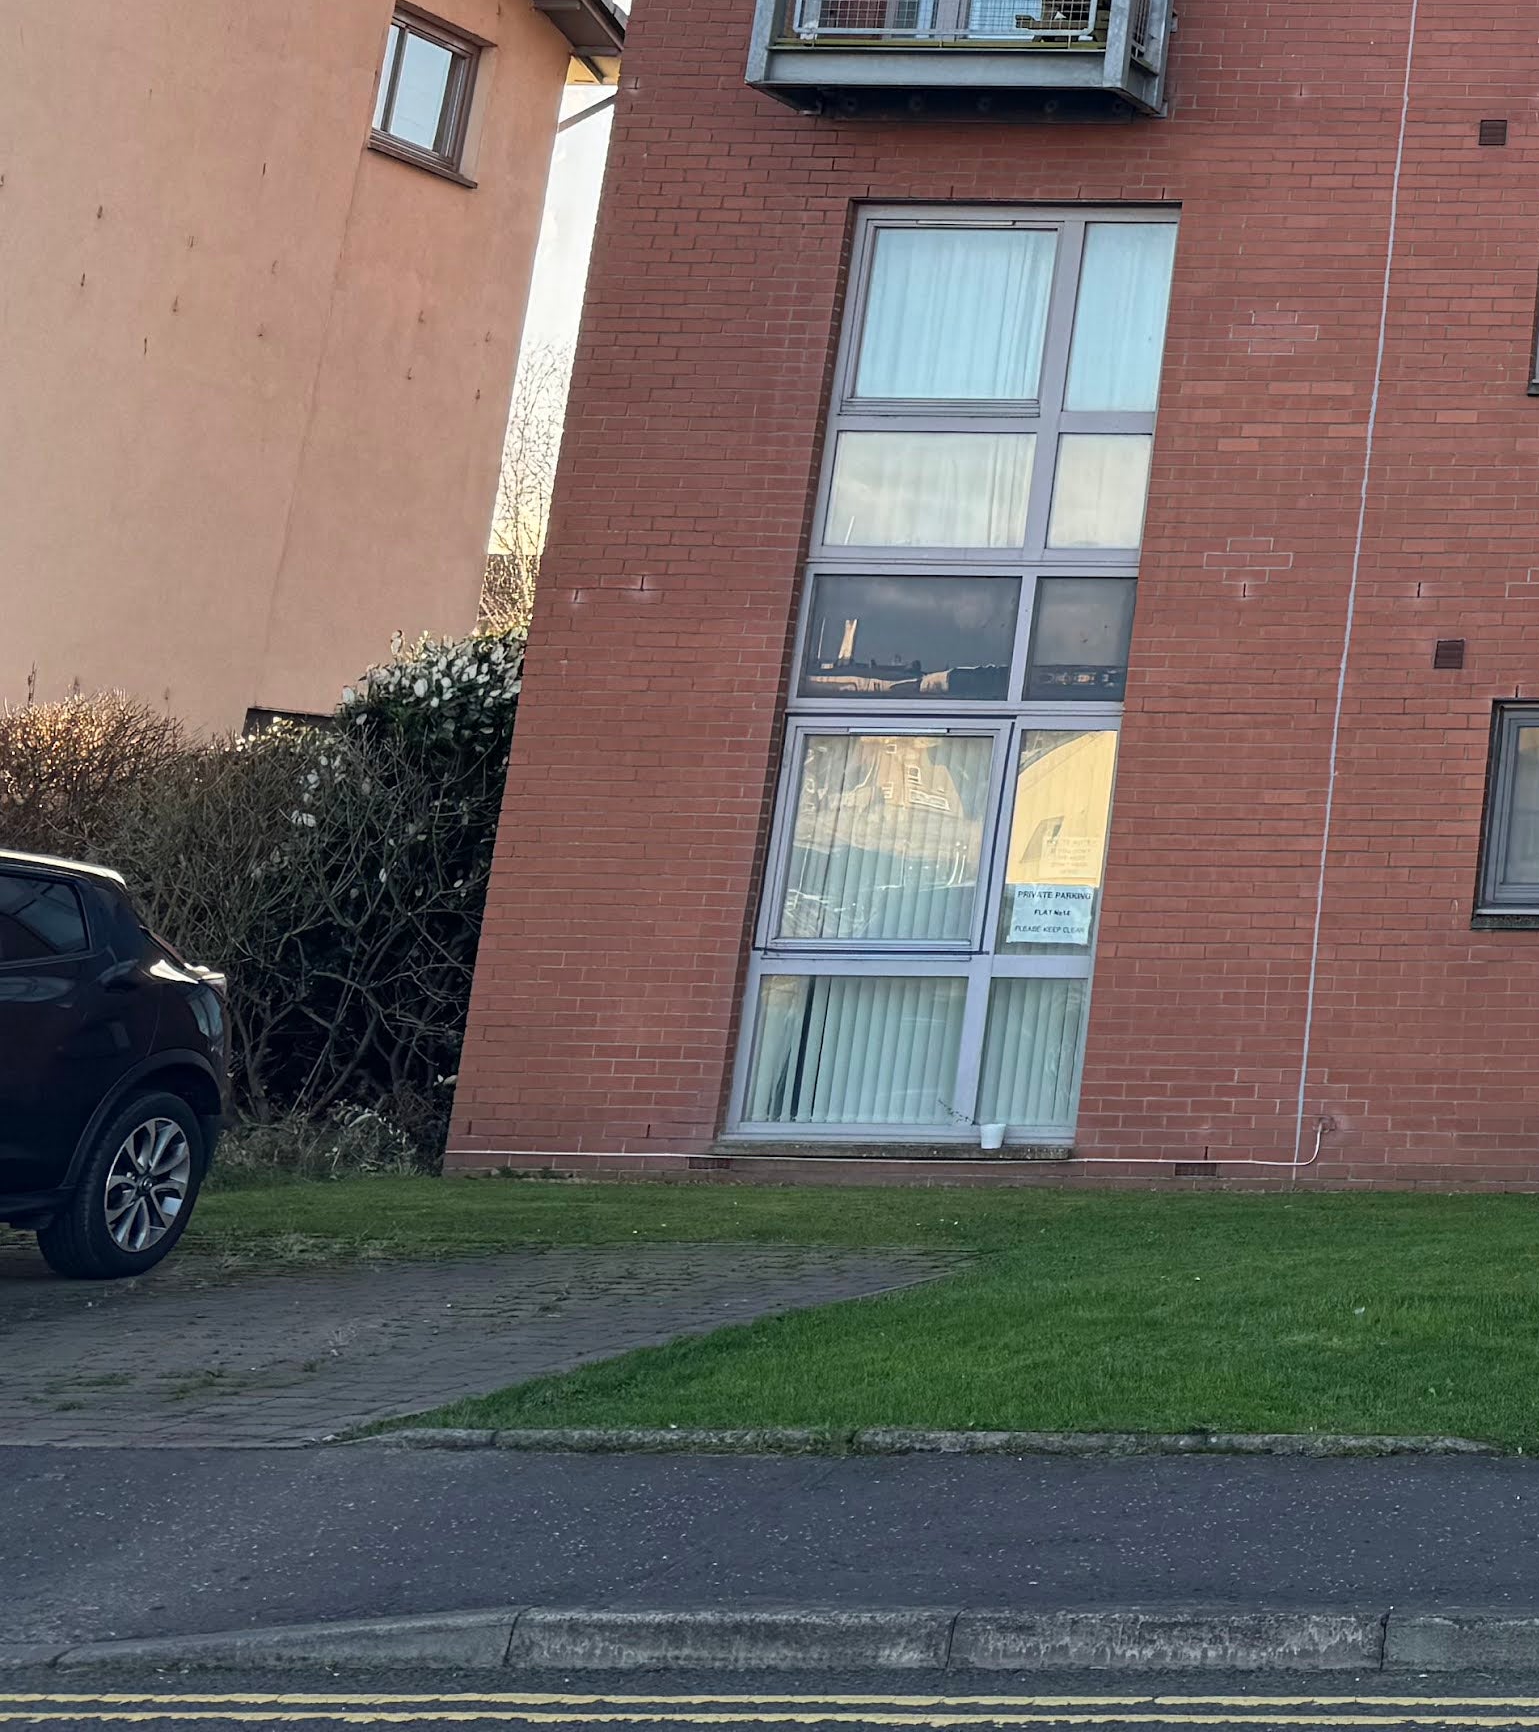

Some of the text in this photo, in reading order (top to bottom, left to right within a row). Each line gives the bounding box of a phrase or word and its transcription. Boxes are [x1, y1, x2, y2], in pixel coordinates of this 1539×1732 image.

[1017, 890, 1092, 900] PRIVATE PARKING
[1014, 925, 1040, 933] PLEASE
